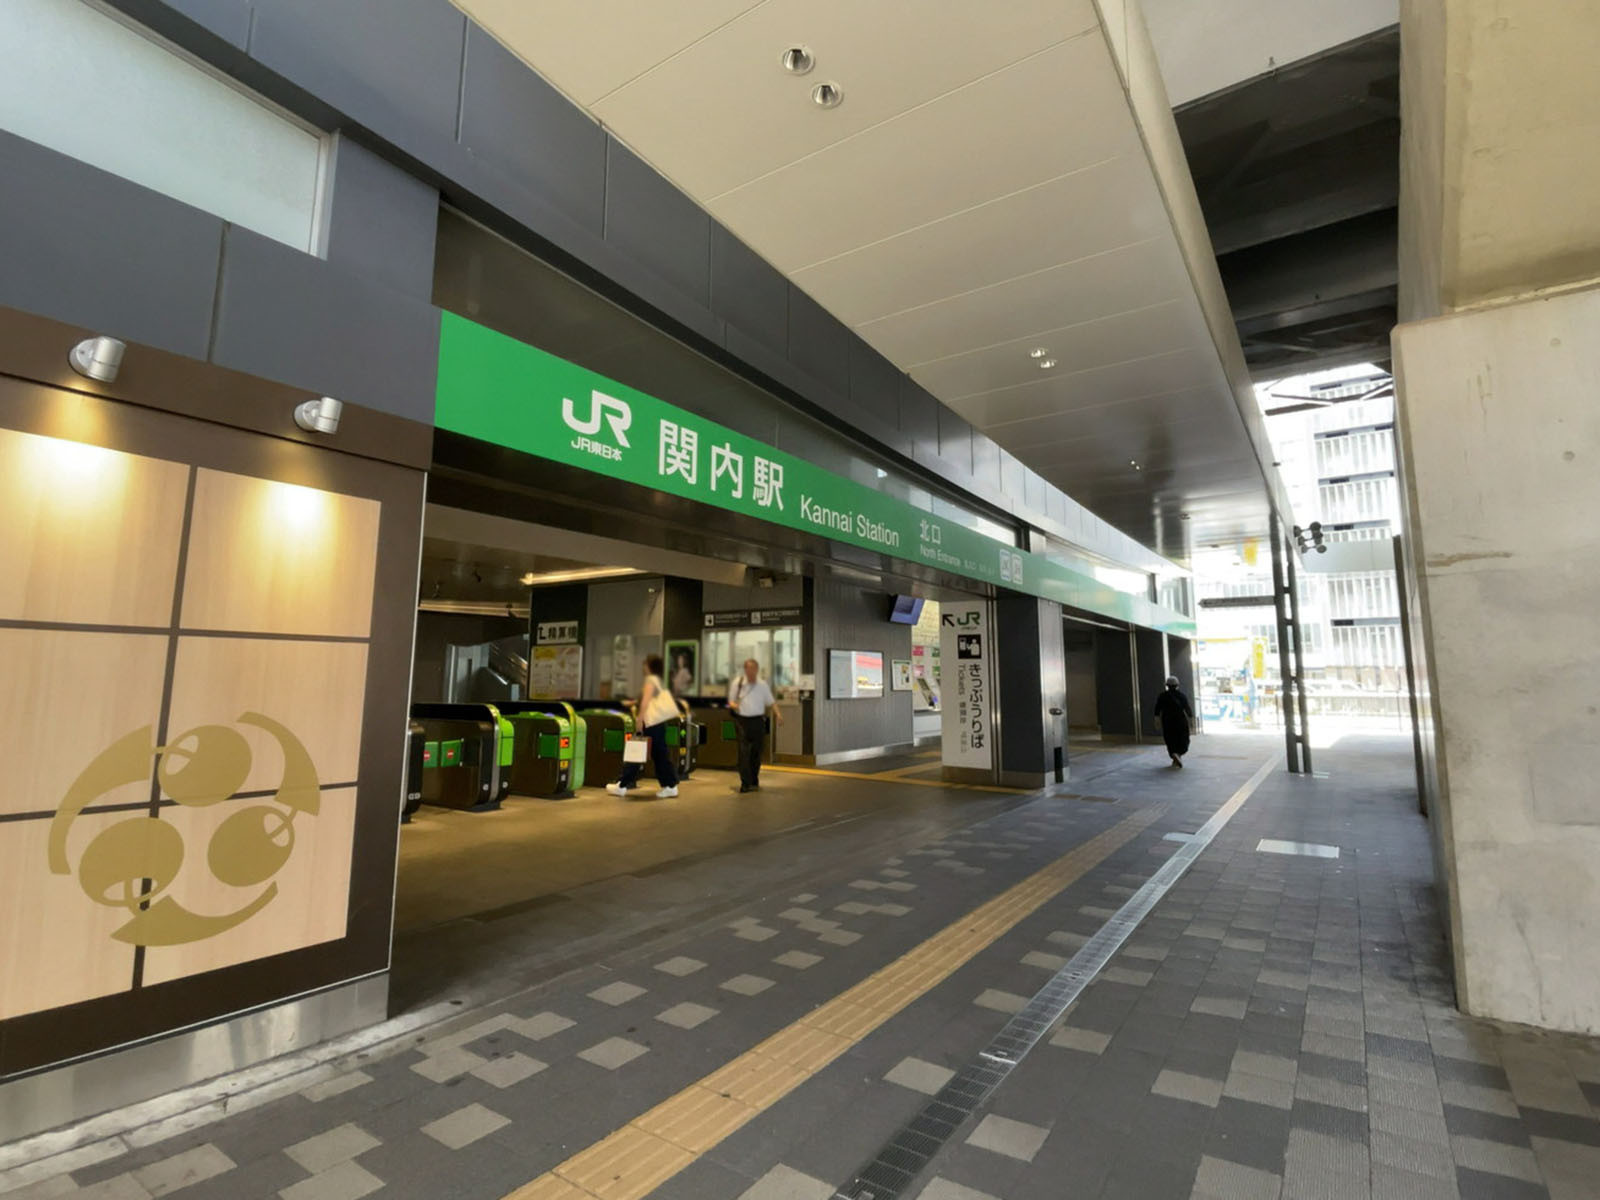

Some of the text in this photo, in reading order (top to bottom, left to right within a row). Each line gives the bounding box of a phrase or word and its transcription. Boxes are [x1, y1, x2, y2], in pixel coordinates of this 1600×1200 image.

[562, 390, 632, 448] JR
[571, 436, 623, 462] JR東日本
[658, 418, 784, 512] 関内駅
[800, 494, 899, 548] Kannai Station
[919, 519, 941, 544] 北口
[919, 543, 937, 560] North
[937, 549, 961, 568] Entrance
[957, 611, 980, 625] JR
